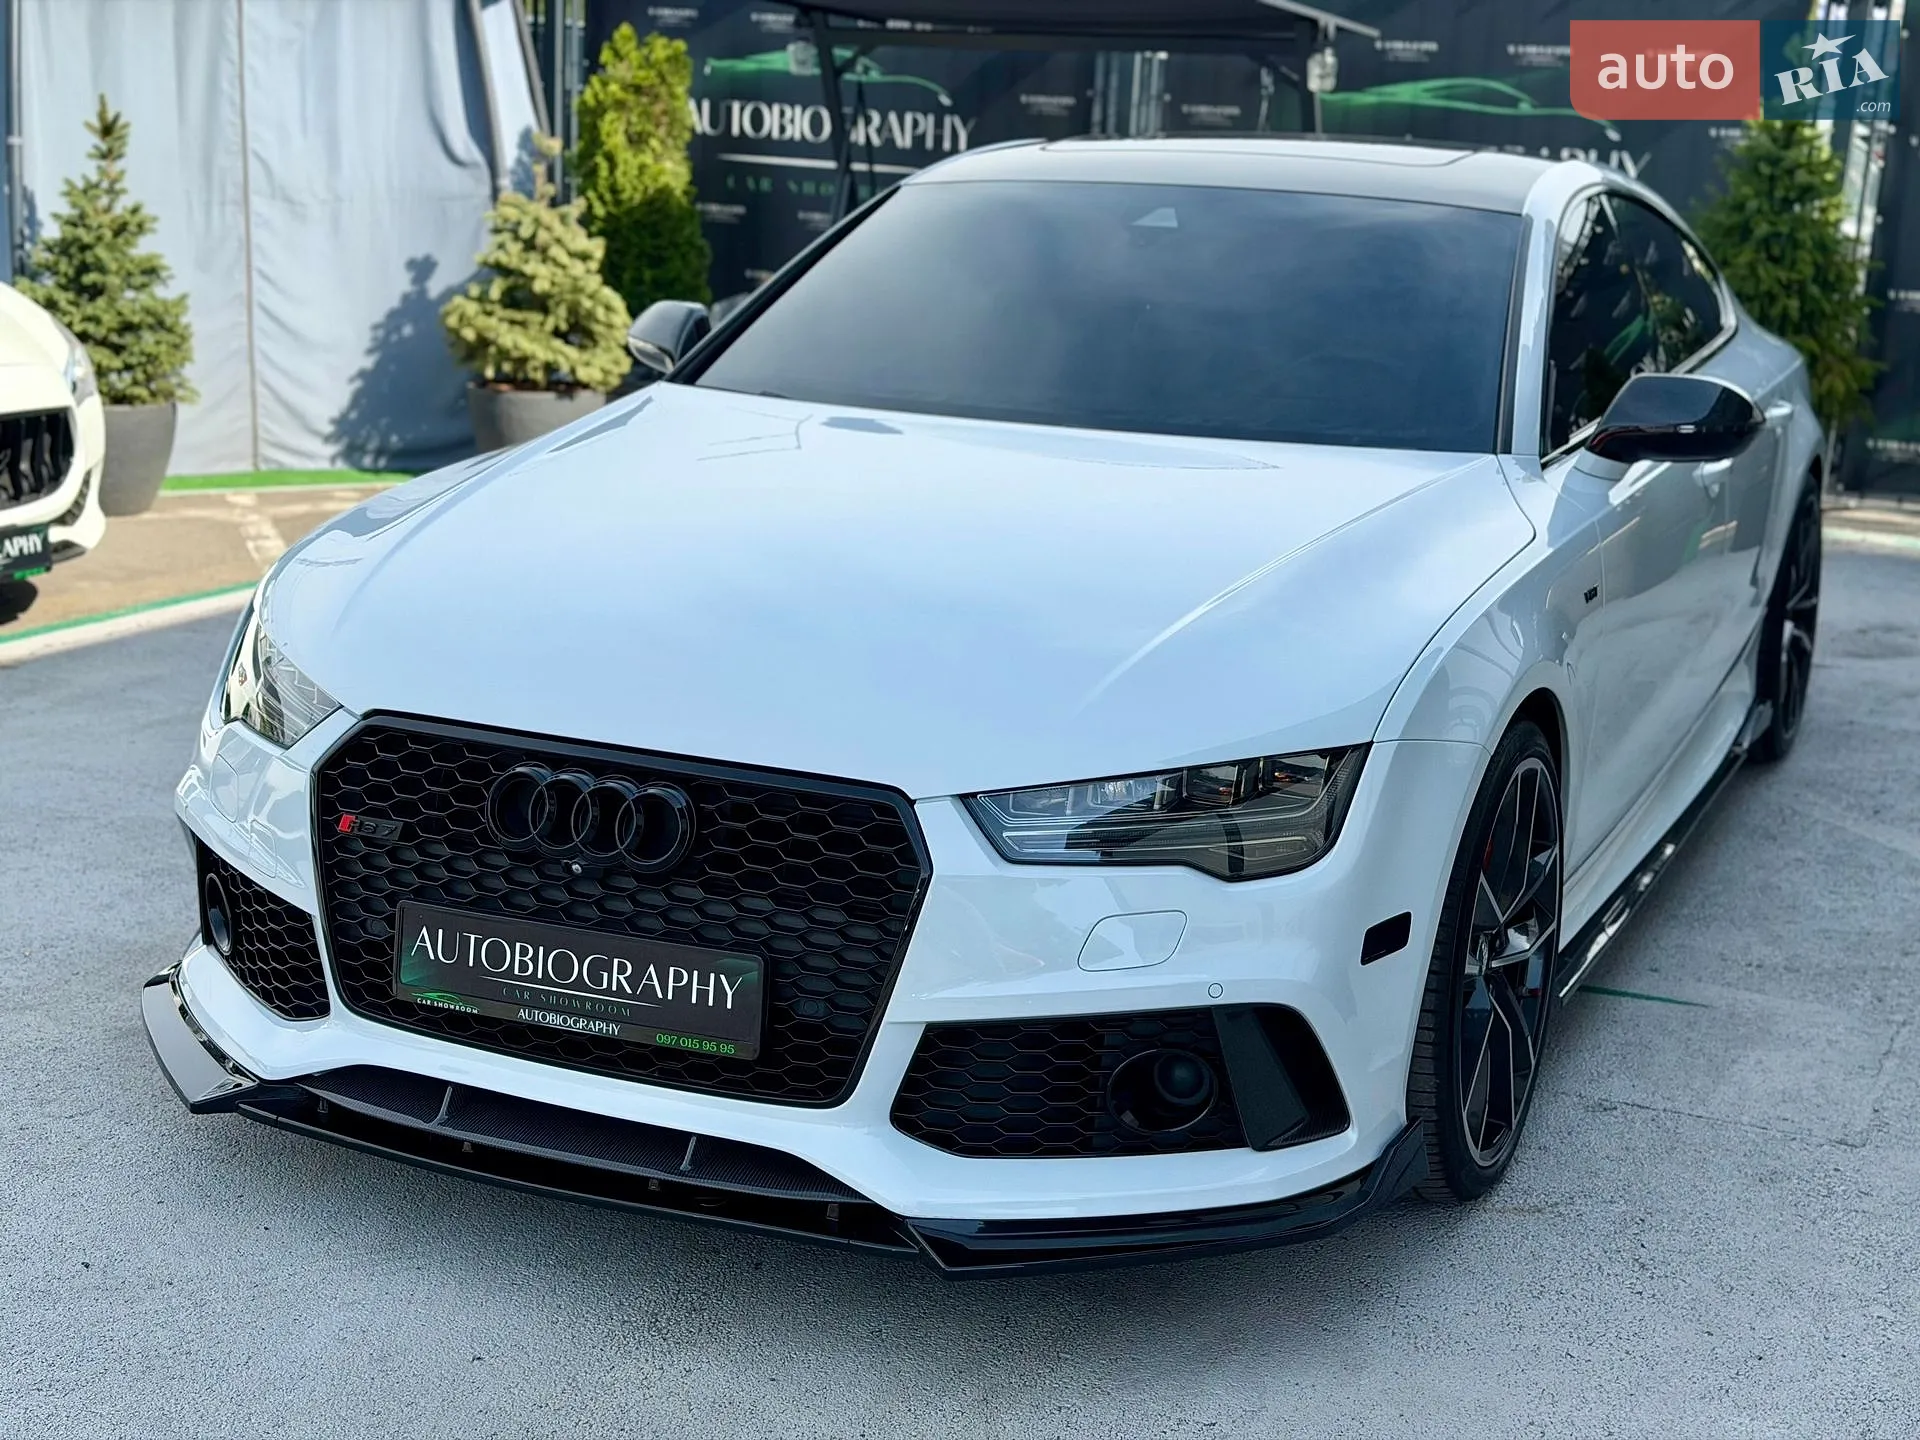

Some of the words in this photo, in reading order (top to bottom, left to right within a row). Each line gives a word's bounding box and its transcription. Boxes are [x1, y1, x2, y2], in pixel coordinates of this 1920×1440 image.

[687, 95, 976, 151] AUTOBIORAPHY
[410, 925, 743, 1010] AUTOBIOGRAPHY
[416, 997, 432, 1007] CAR
[433, 1000, 479, 1015] SHOWROOM
[502, 986, 531, 1001] CAR
[540, 993, 631, 1017] SHOWROOM
[517, 1007, 622, 1036] AUTOBIOGRAPHY
[656, 1033, 677, 1046] 097
[680, 1036, 700, 1049] 015
[702, 1040, 718, 1052] 95
[719, 1042, 736, 1055] 95
